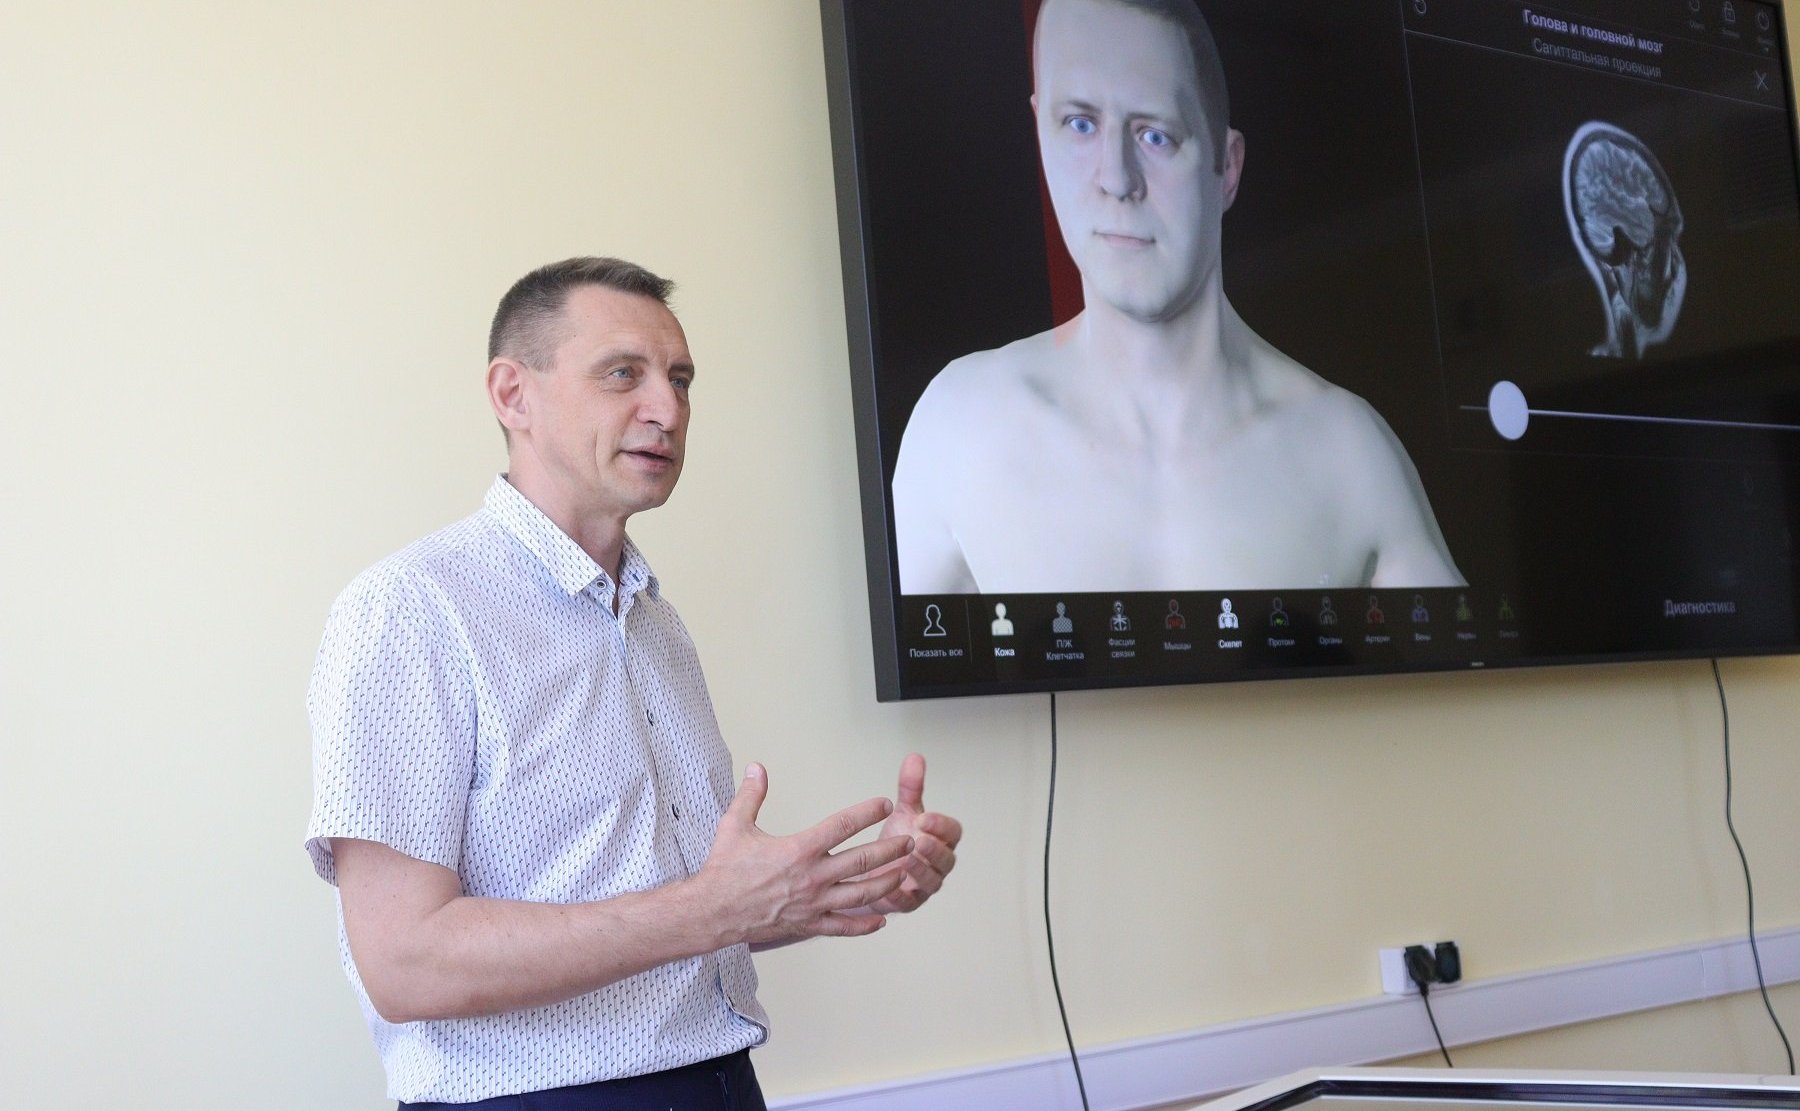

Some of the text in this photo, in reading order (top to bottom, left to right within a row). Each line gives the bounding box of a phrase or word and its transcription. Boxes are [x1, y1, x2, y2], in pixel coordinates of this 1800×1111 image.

[1523, 9, 1664, 54] Голова и головной мозг
[1532, 37, 1662, 78] Сагиттальная проекция
[1664, 599, 1736, 618] Диагностика
[1108, 637, 1136, 647] Фасции
[1218, 639, 1243, 648] Скелет
[1268, 637, 1296, 648] Протоки
[909, 648, 963, 658] Показать все
[994, 647, 1015, 657] Кожа
[1046, 651, 1084, 661] Клетчатка
